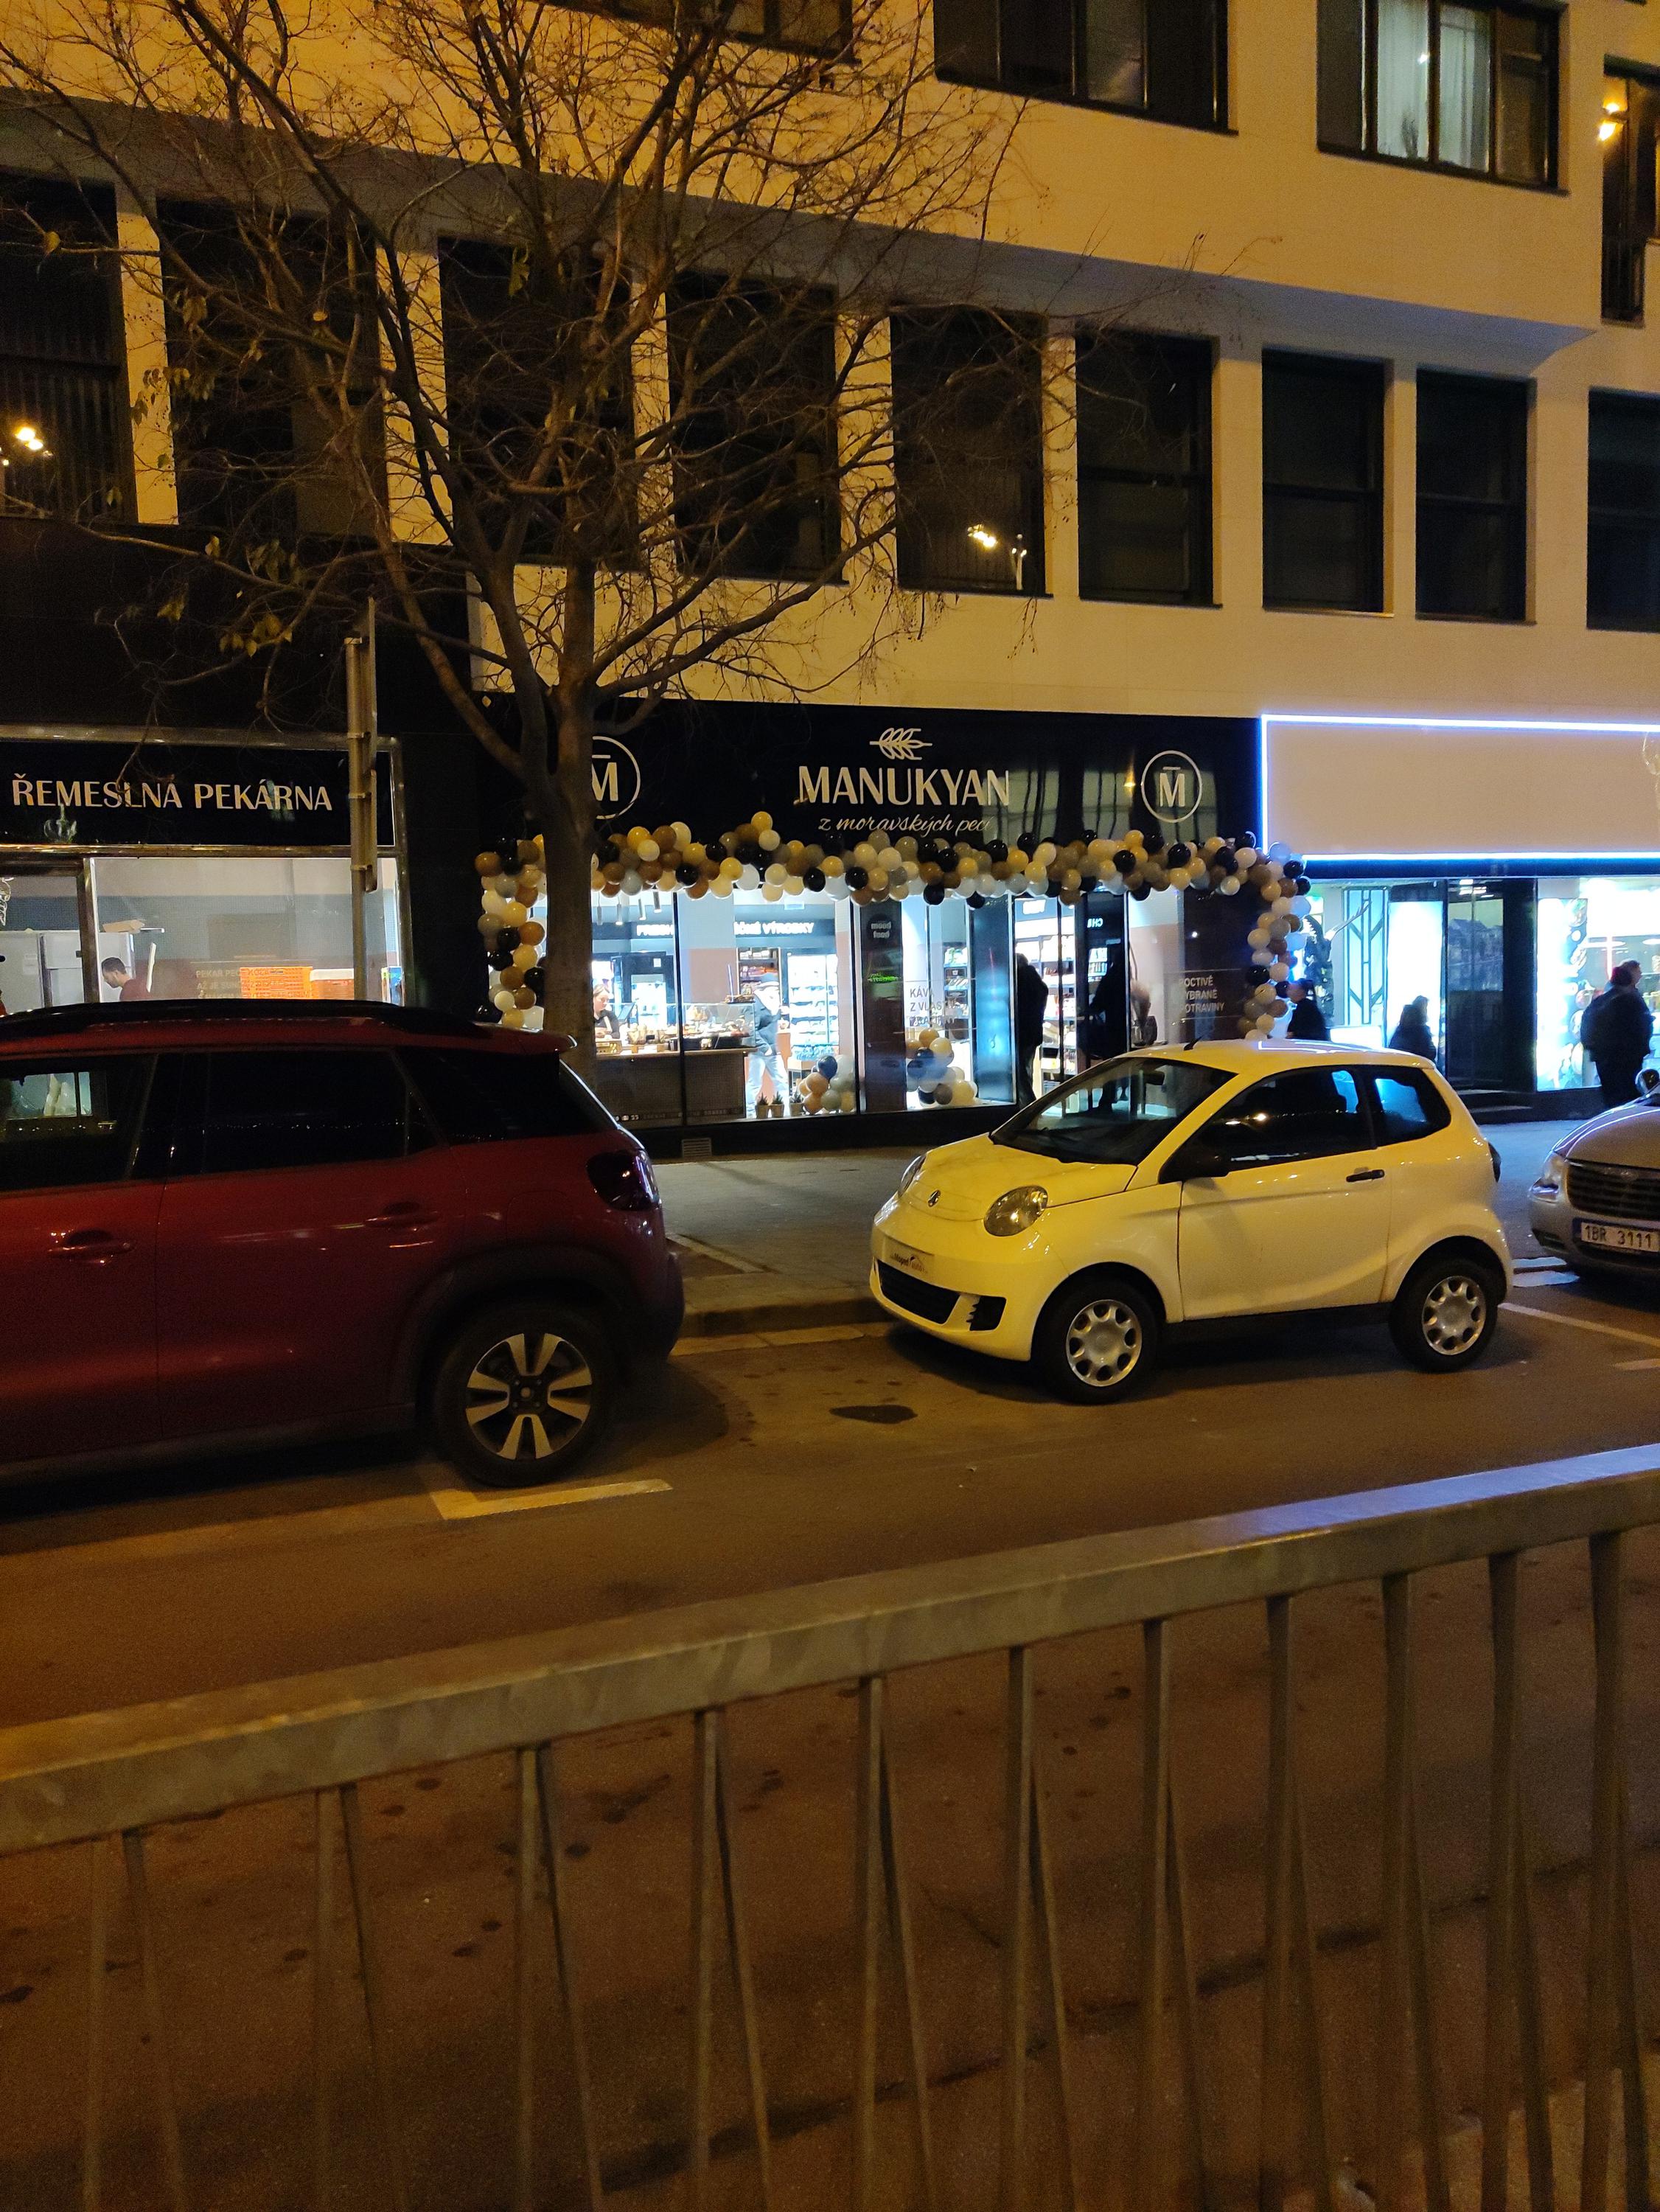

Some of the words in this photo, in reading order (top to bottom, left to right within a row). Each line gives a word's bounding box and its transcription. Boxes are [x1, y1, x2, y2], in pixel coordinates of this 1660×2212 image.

[194, 779, 332, 811] PEKÁRNA
[798, 765, 1009, 806] MANUKYAN
[818, 817, 831, 831] z
[837, 813, 954, 837] moravských
[871, 922, 891, 930] mood
[873, 931, 890, 939] food
[1584, 1225, 1606, 1242] 1BR
[1617, 1230, 1651, 1248] 3111
